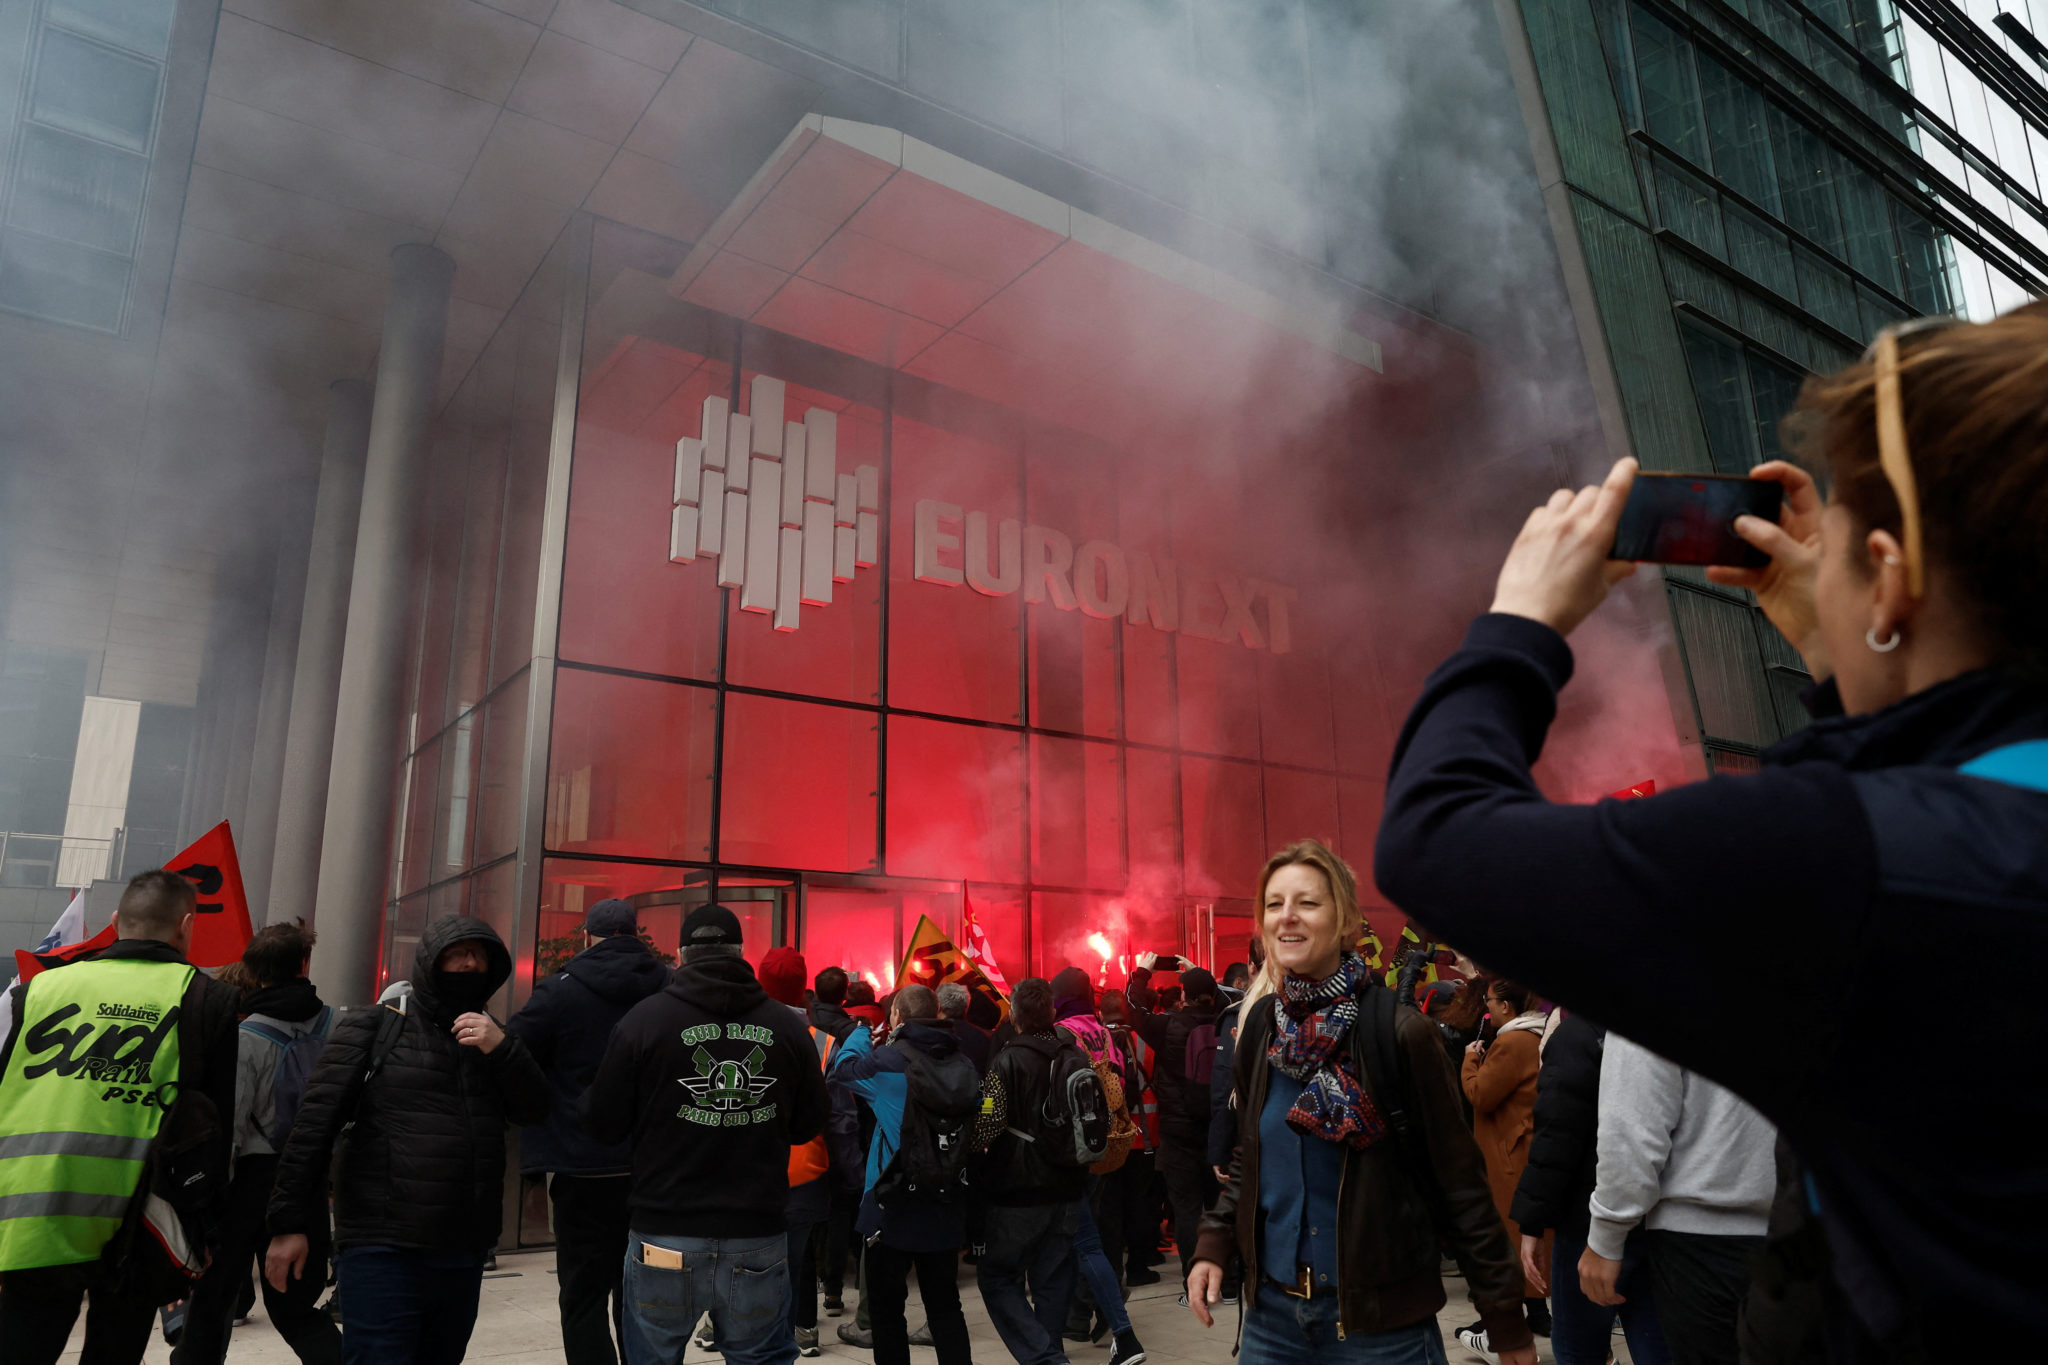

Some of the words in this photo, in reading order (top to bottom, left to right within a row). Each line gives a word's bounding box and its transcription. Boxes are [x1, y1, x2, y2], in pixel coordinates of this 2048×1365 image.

[913, 499, 1298, 655] EURONEXT
[97, 1003, 160, 1021] Solidaires
[24, 1003, 180, 1080] Sud
[681, 1023, 721, 1046] SUD
[726, 1023, 774, 1046] RAIL
[74, 1056, 153, 1085] Rail
[677, 1104, 721, 1126] PARIS
[723, 1111, 749, 1127] SUD
[751, 1103, 777, 1123] EST
